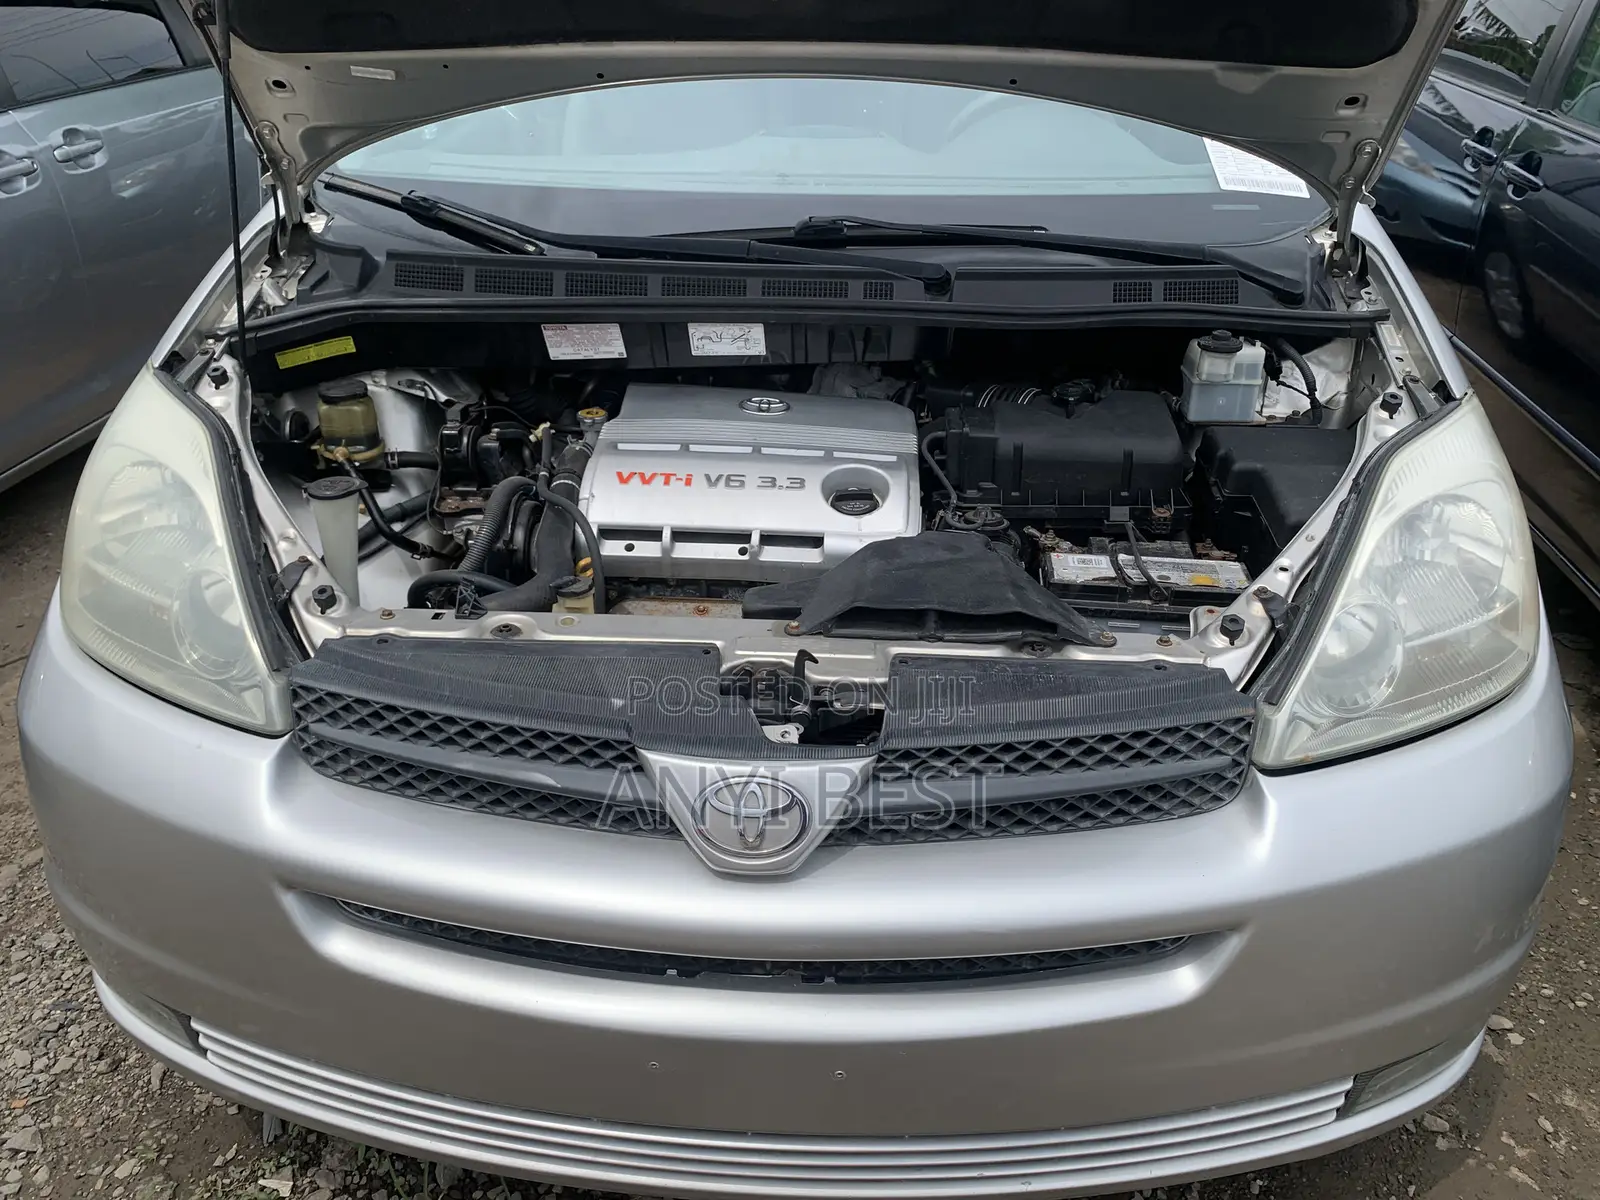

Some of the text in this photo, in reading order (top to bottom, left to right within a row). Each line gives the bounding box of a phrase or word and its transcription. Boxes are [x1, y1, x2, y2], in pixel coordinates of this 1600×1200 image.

[615, 471, 806, 491] VVT-i V6 3.3
